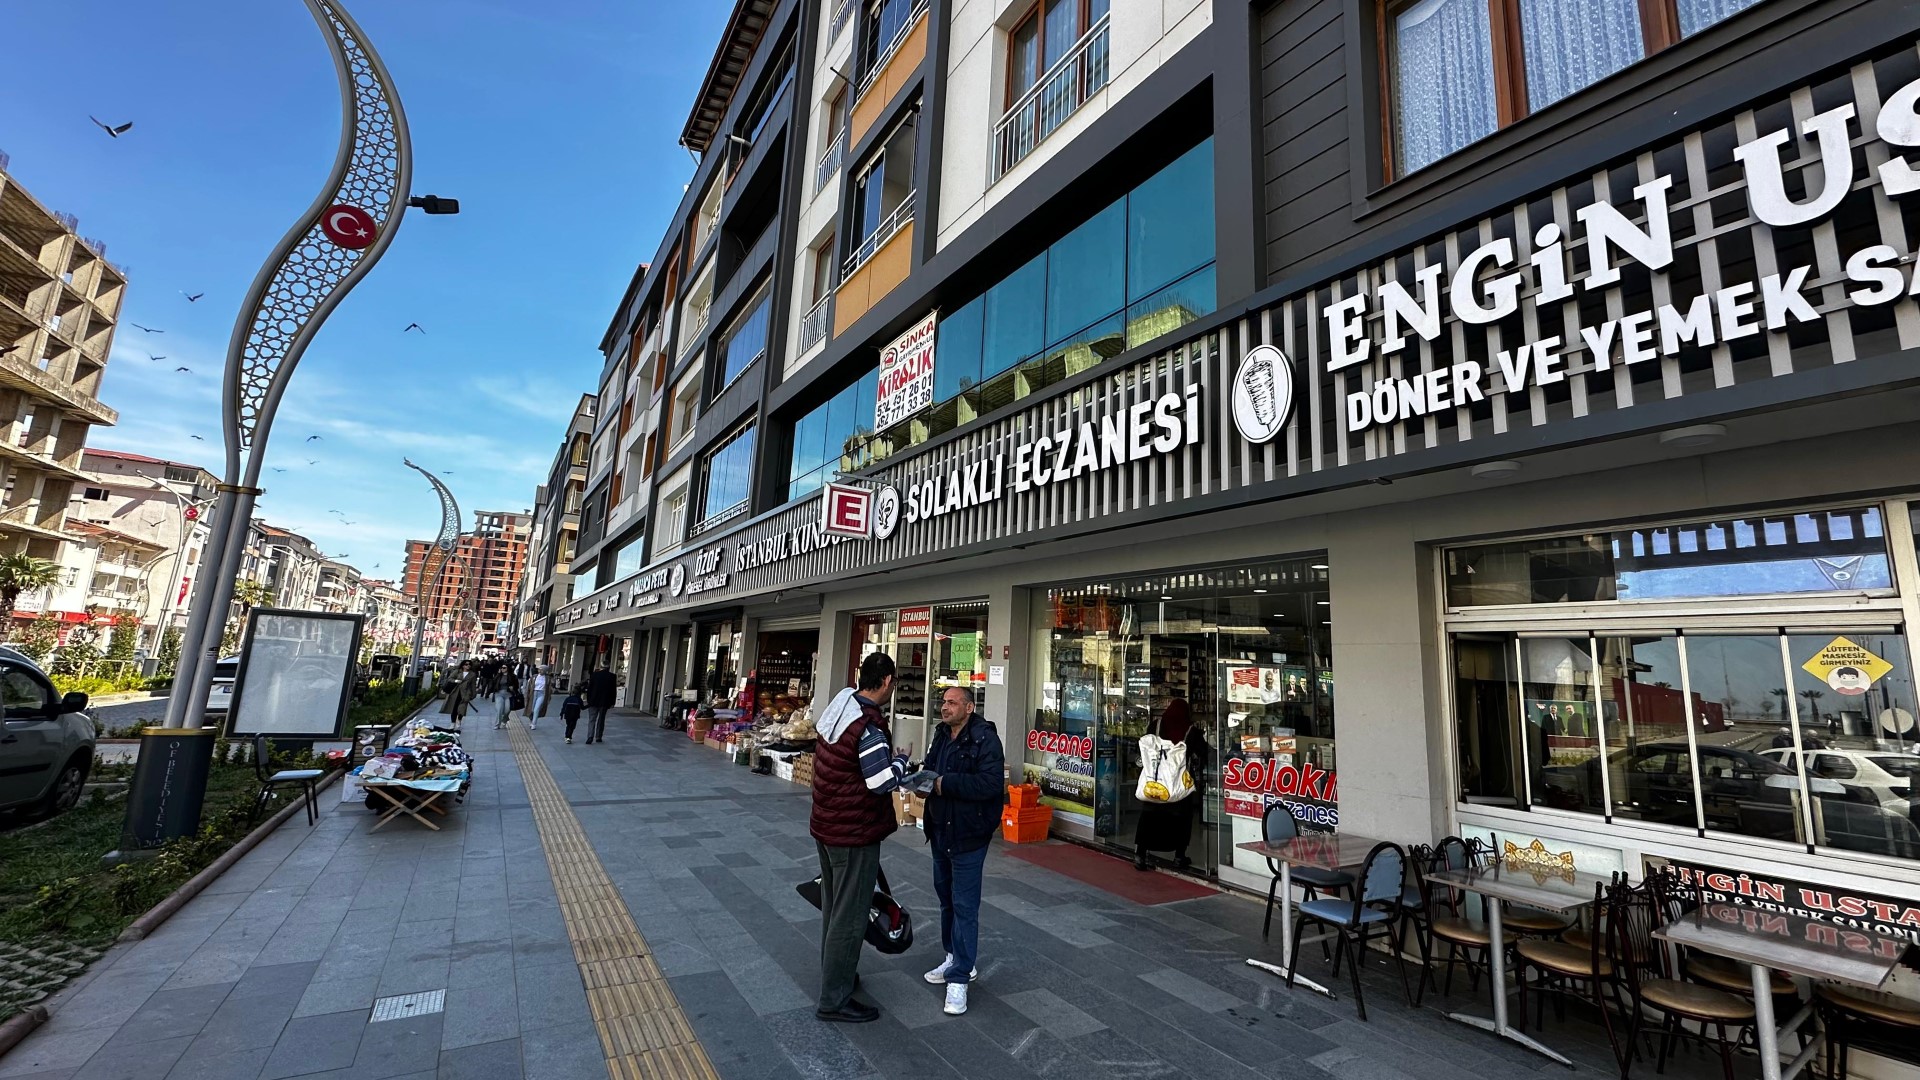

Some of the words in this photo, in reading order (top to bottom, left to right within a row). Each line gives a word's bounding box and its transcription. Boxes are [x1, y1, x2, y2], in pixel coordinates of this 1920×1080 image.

[1347, 360, 1484, 432] DÖNER
[1497, 336, 1564, 392] VE
[1580, 265, 1821, 373] YEMEK
[1846, 243, 1920, 306] S
[908, 381, 920, 398] 26
[921, 373, 932, 391] 01
[891, 402, 905, 421] 771
[907, 396, 918, 414] 33
[920, 389, 931, 403] 38
[906, 454, 1005, 524] SOLAKLI
[836, 494, 862, 528] E
[900, 625, 929, 636] KUNDURA
[1027, 729, 1093, 759] eczane
